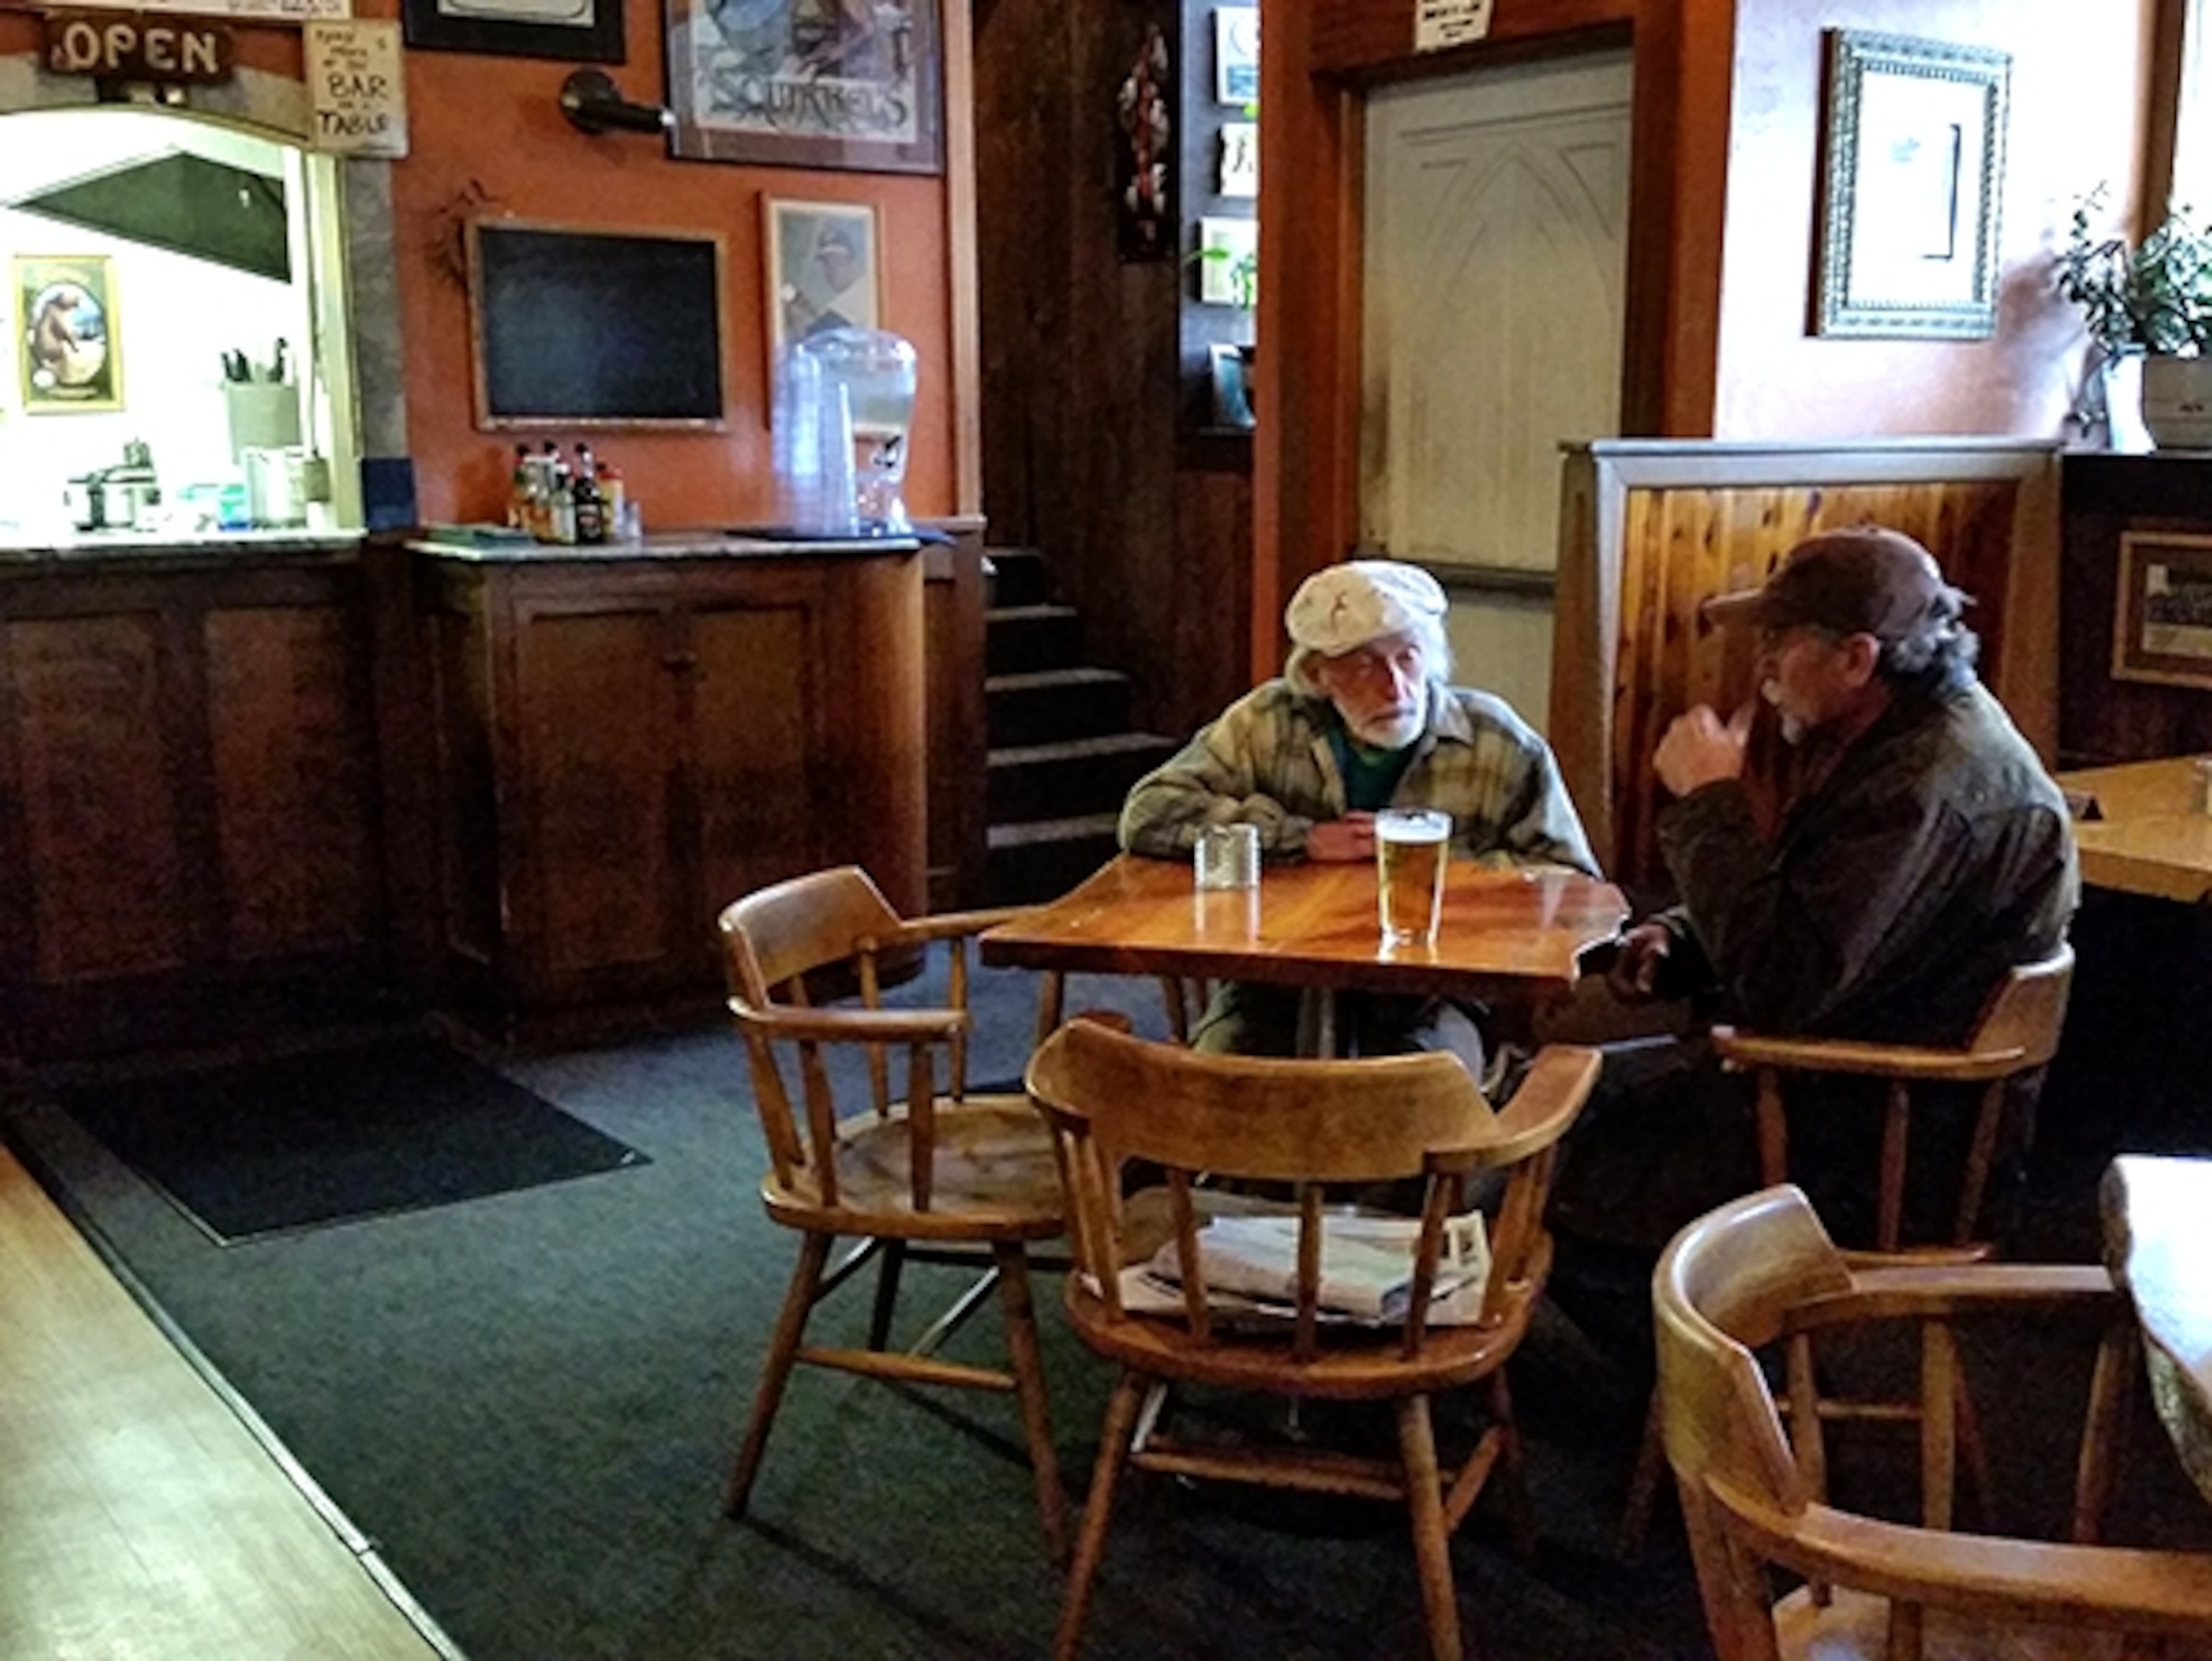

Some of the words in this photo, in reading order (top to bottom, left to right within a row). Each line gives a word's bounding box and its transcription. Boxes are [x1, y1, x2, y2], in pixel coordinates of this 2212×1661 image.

[63, 22, 219, 73] OPEN
[328, 72, 389, 99] BAR
[315, 109, 389, 135] TABLE
